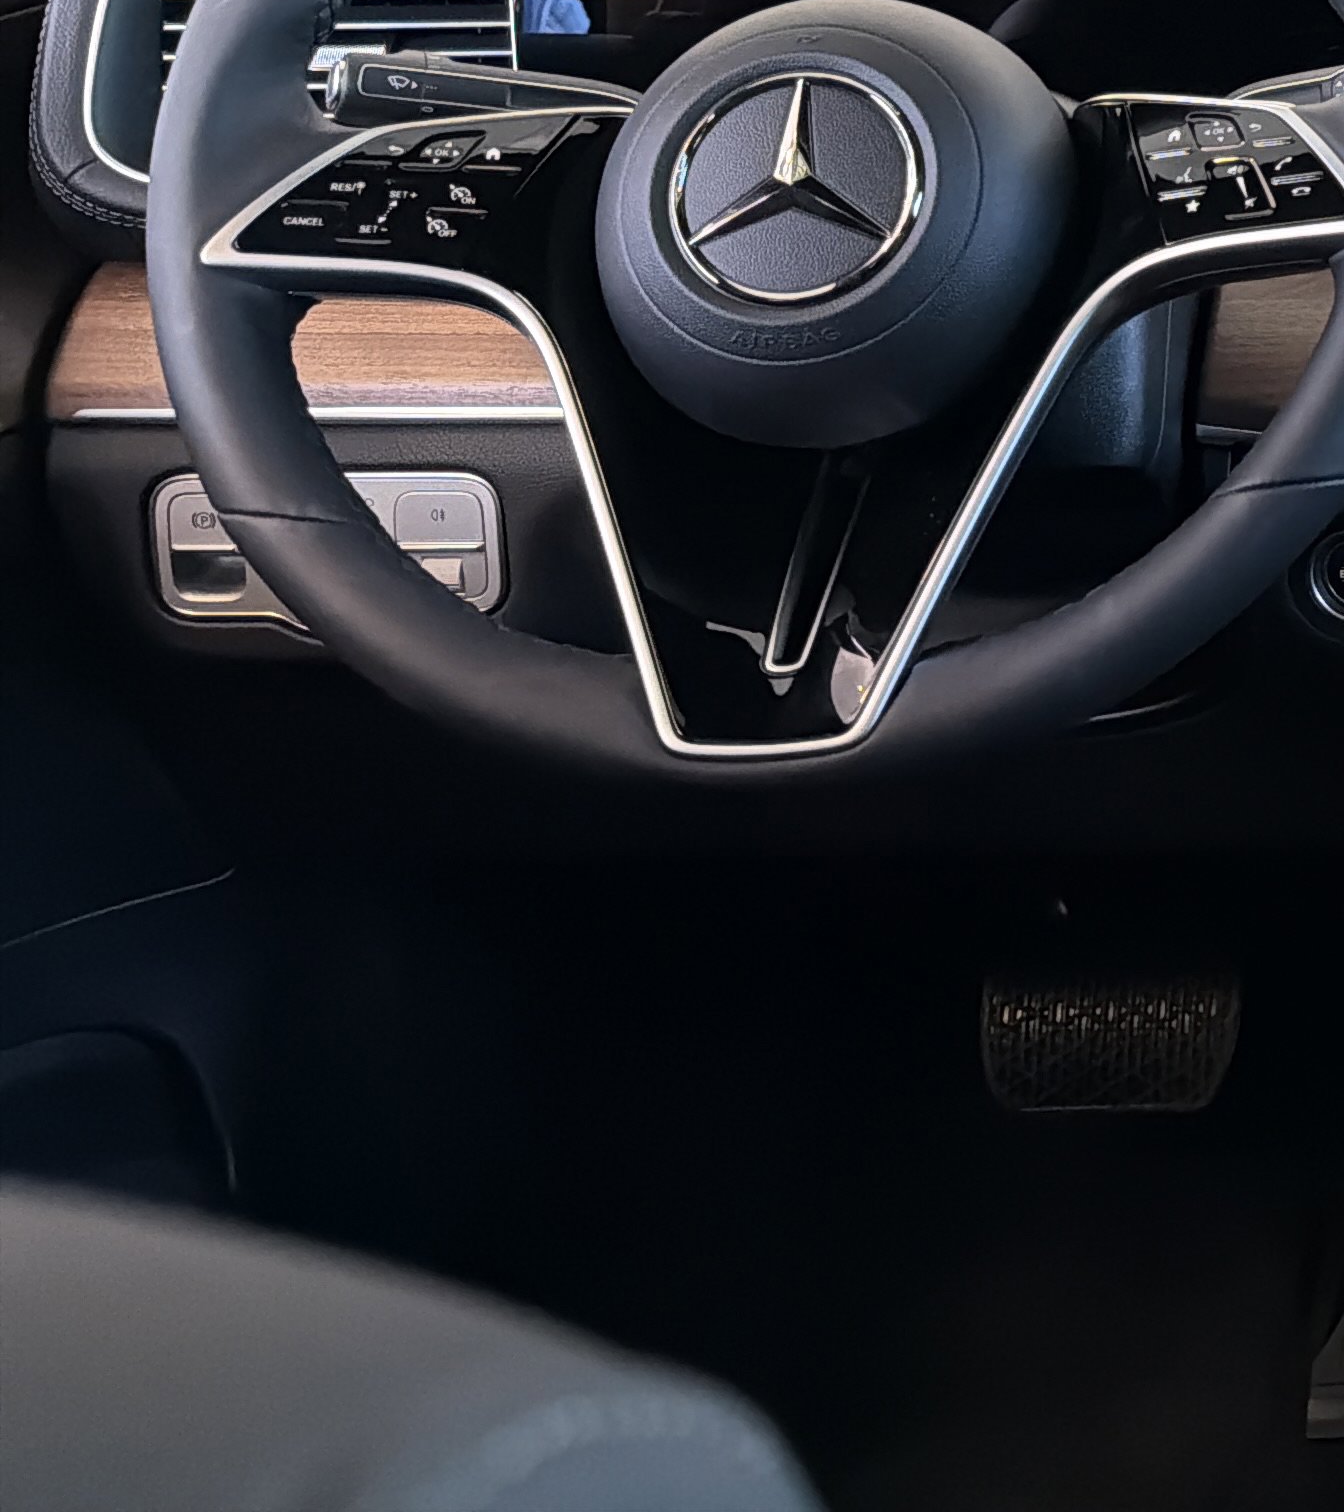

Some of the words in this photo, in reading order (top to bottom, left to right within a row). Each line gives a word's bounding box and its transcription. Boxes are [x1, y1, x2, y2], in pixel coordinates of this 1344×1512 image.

[434, 149, 450, 157] OK
[461, 196, 476, 205] ON
[283, 216, 325, 227] CANCEL
[437, 229, 457, 238] OFF
